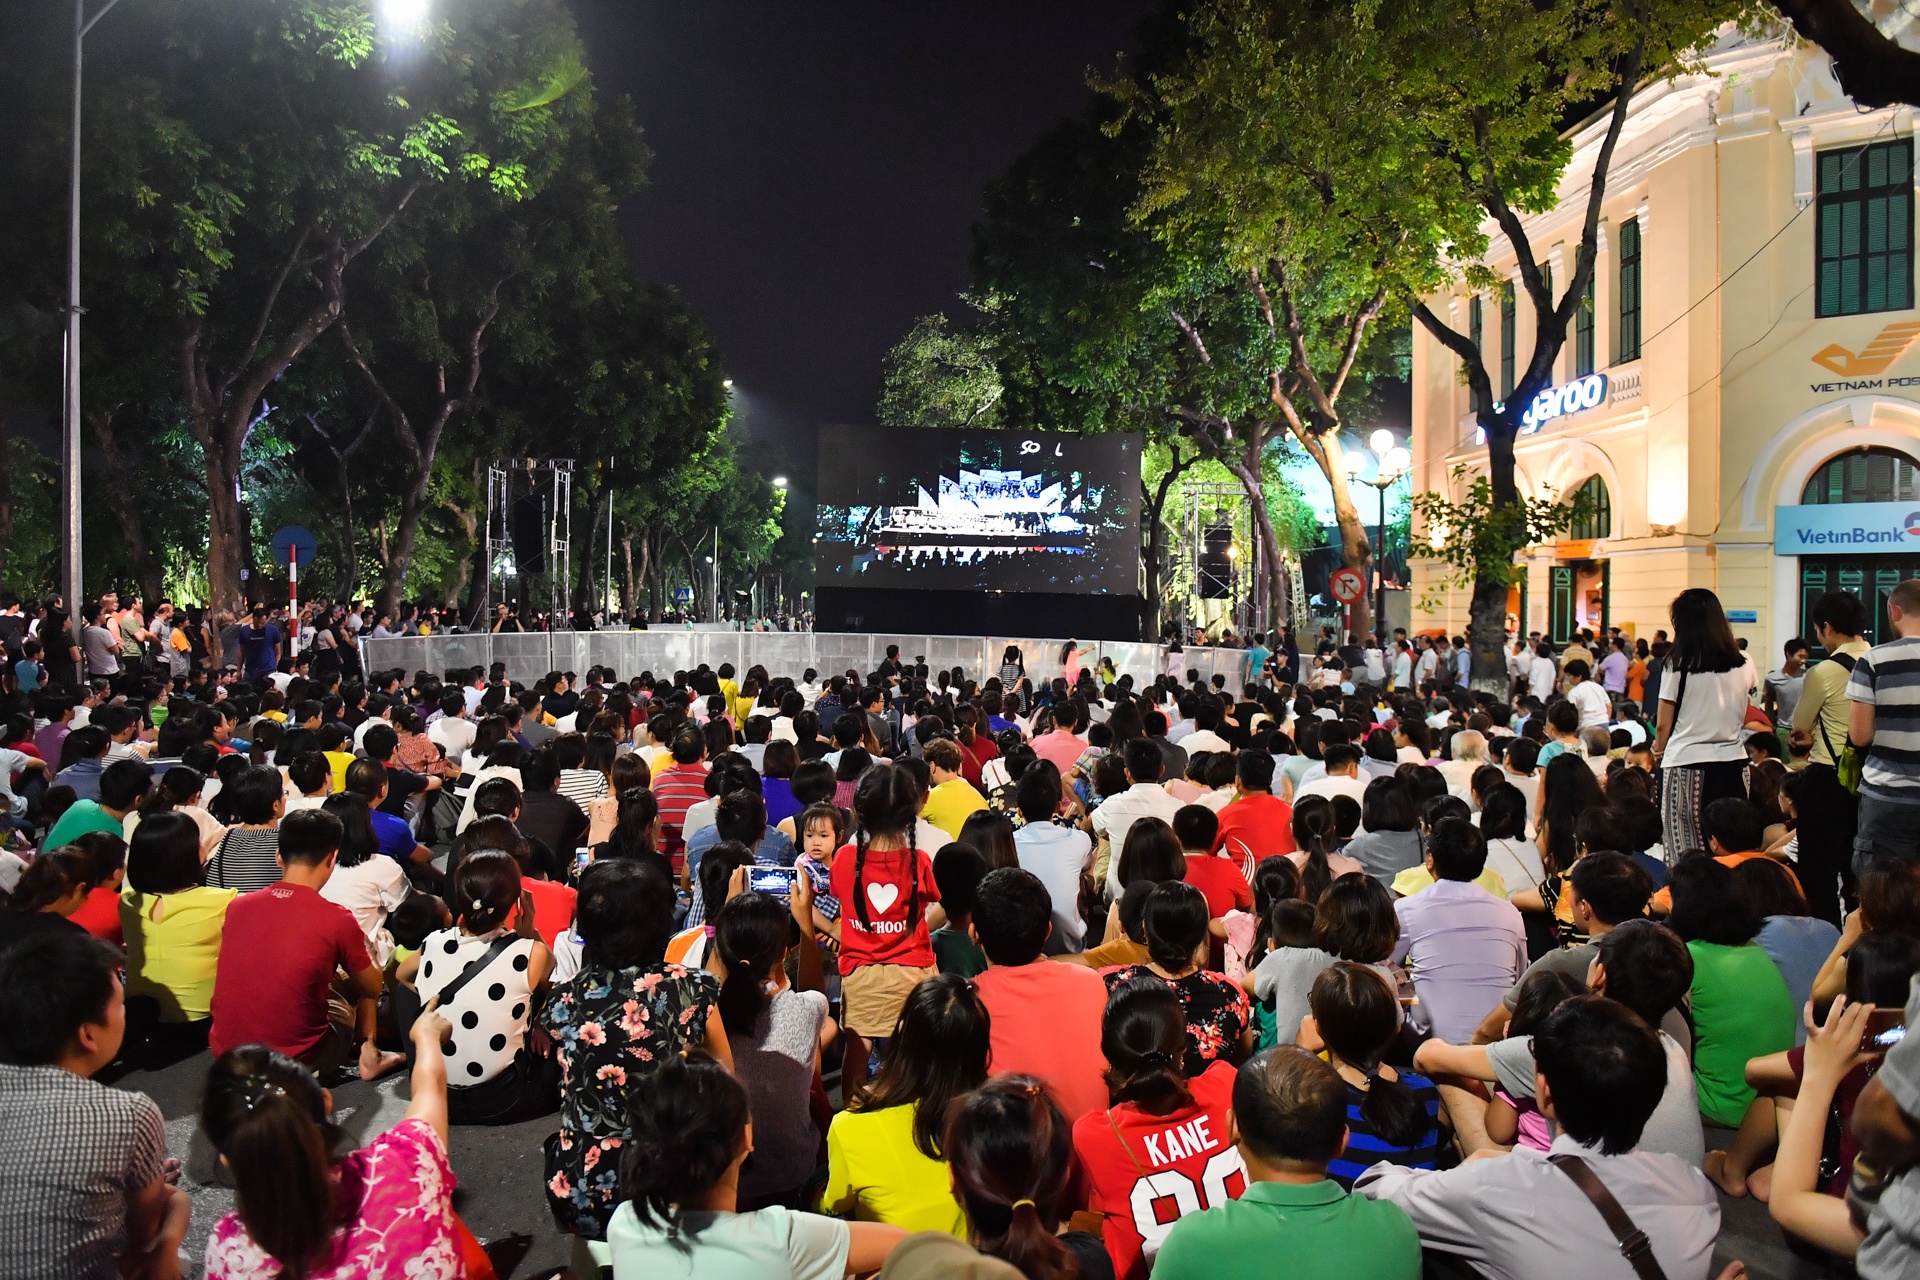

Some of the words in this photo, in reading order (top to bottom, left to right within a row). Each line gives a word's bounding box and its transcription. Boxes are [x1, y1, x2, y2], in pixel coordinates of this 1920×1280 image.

[1811, 380, 1882, 393] VIETNAM
[1476, 375, 1603, 446] garoo
[1797, 526, 1905, 544] VietinBank
[1143, 1114, 1219, 1167] KANE
